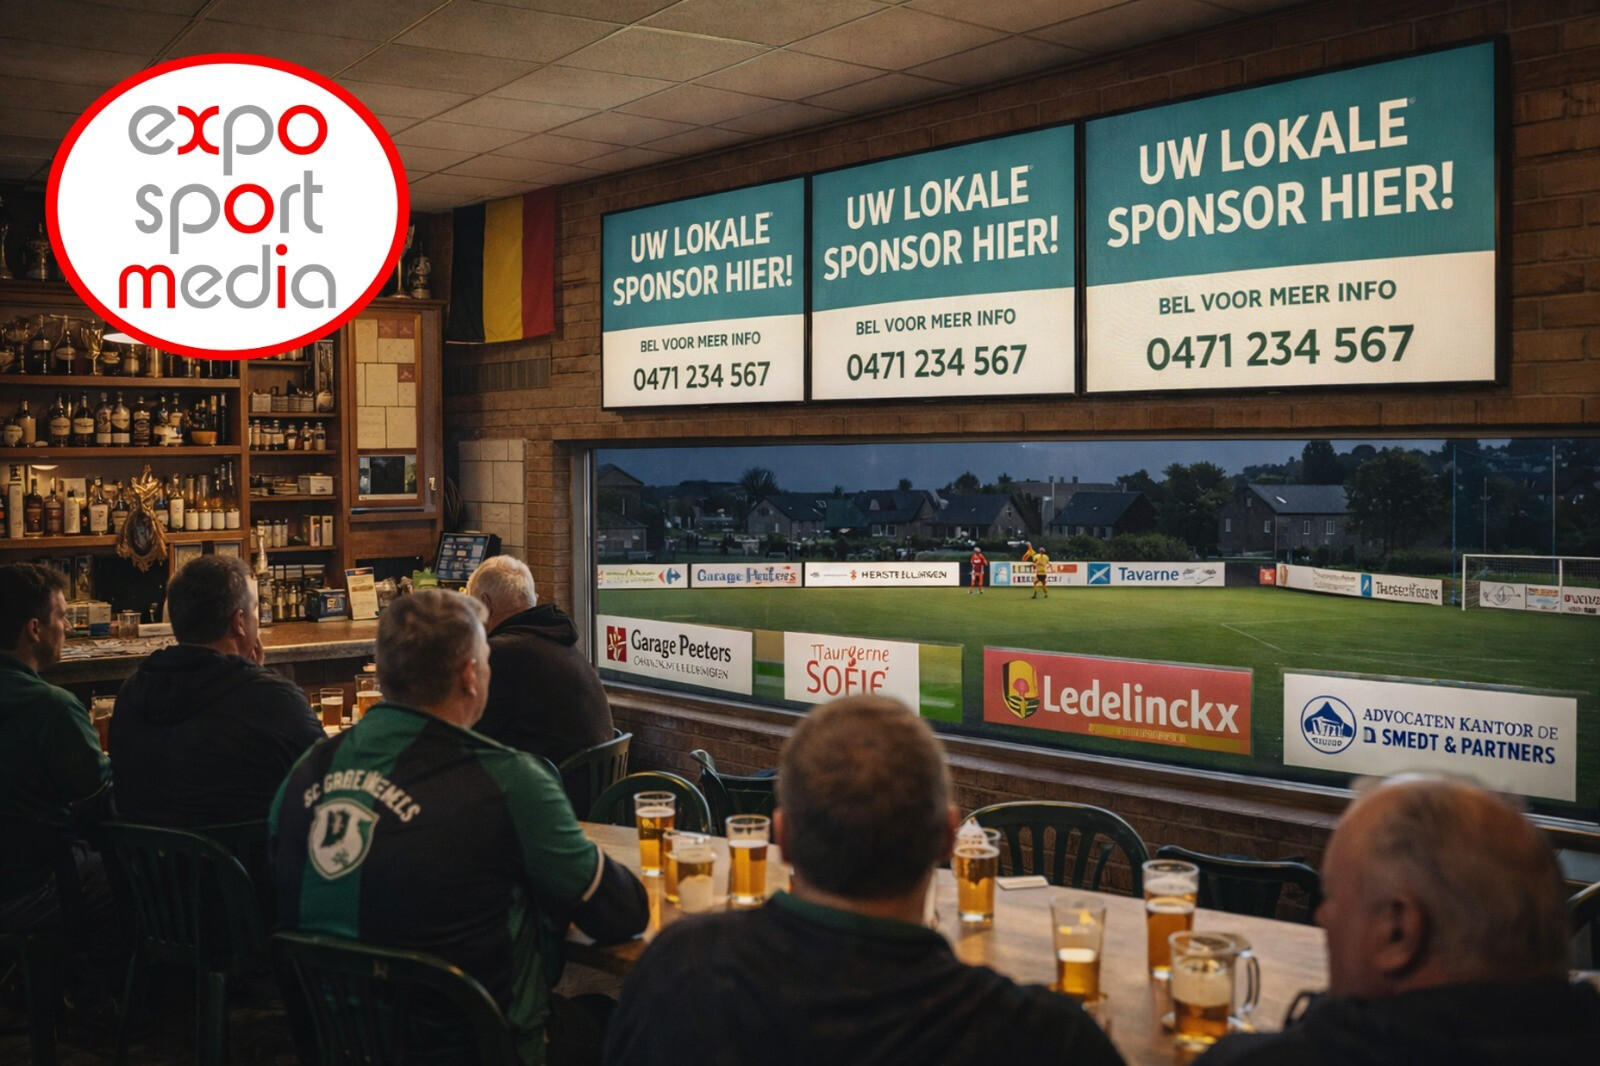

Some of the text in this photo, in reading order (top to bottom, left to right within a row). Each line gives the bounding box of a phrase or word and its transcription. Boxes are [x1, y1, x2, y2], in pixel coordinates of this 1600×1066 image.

[1139, 97, 1408, 185] UW LOKALE
[847, 165, 1029, 230] UW LOKALE
[1106, 160, 1455, 248] SPONSOR HIER!
[631, 211, 771, 264] UW LOKALE
[823, 215, 1059, 281] SPONSOR HIER!
[613, 254, 793, 306] SPONSOR HIER!
[1159, 279, 1397, 315] BEL VOOR MEER INFO
[856, 308, 1016, 336] BEL VOOR MEER INFO
[640, 331, 761, 352] BEL VOOR MEER INFO
[1146, 324, 1414, 371] 0471 234 567
[633, 361, 771, 391] 0471 234 567
[846, 344, 1027, 381] 0471 234 567
[1118, 566, 1179, 582] Tavarne
[631, 629, 731, 662] Garage Peeters
[1043, 675, 1239, 733] Ledelinckx
[1363, 708, 1455, 730] ADVOCATEN
[1537, 725, 1559, 741] DE
[1382, 728, 1439, 751] SMEDT
[1444, 736, 1456, 754] &
[1461, 737, 1556, 765] PARTNERS
